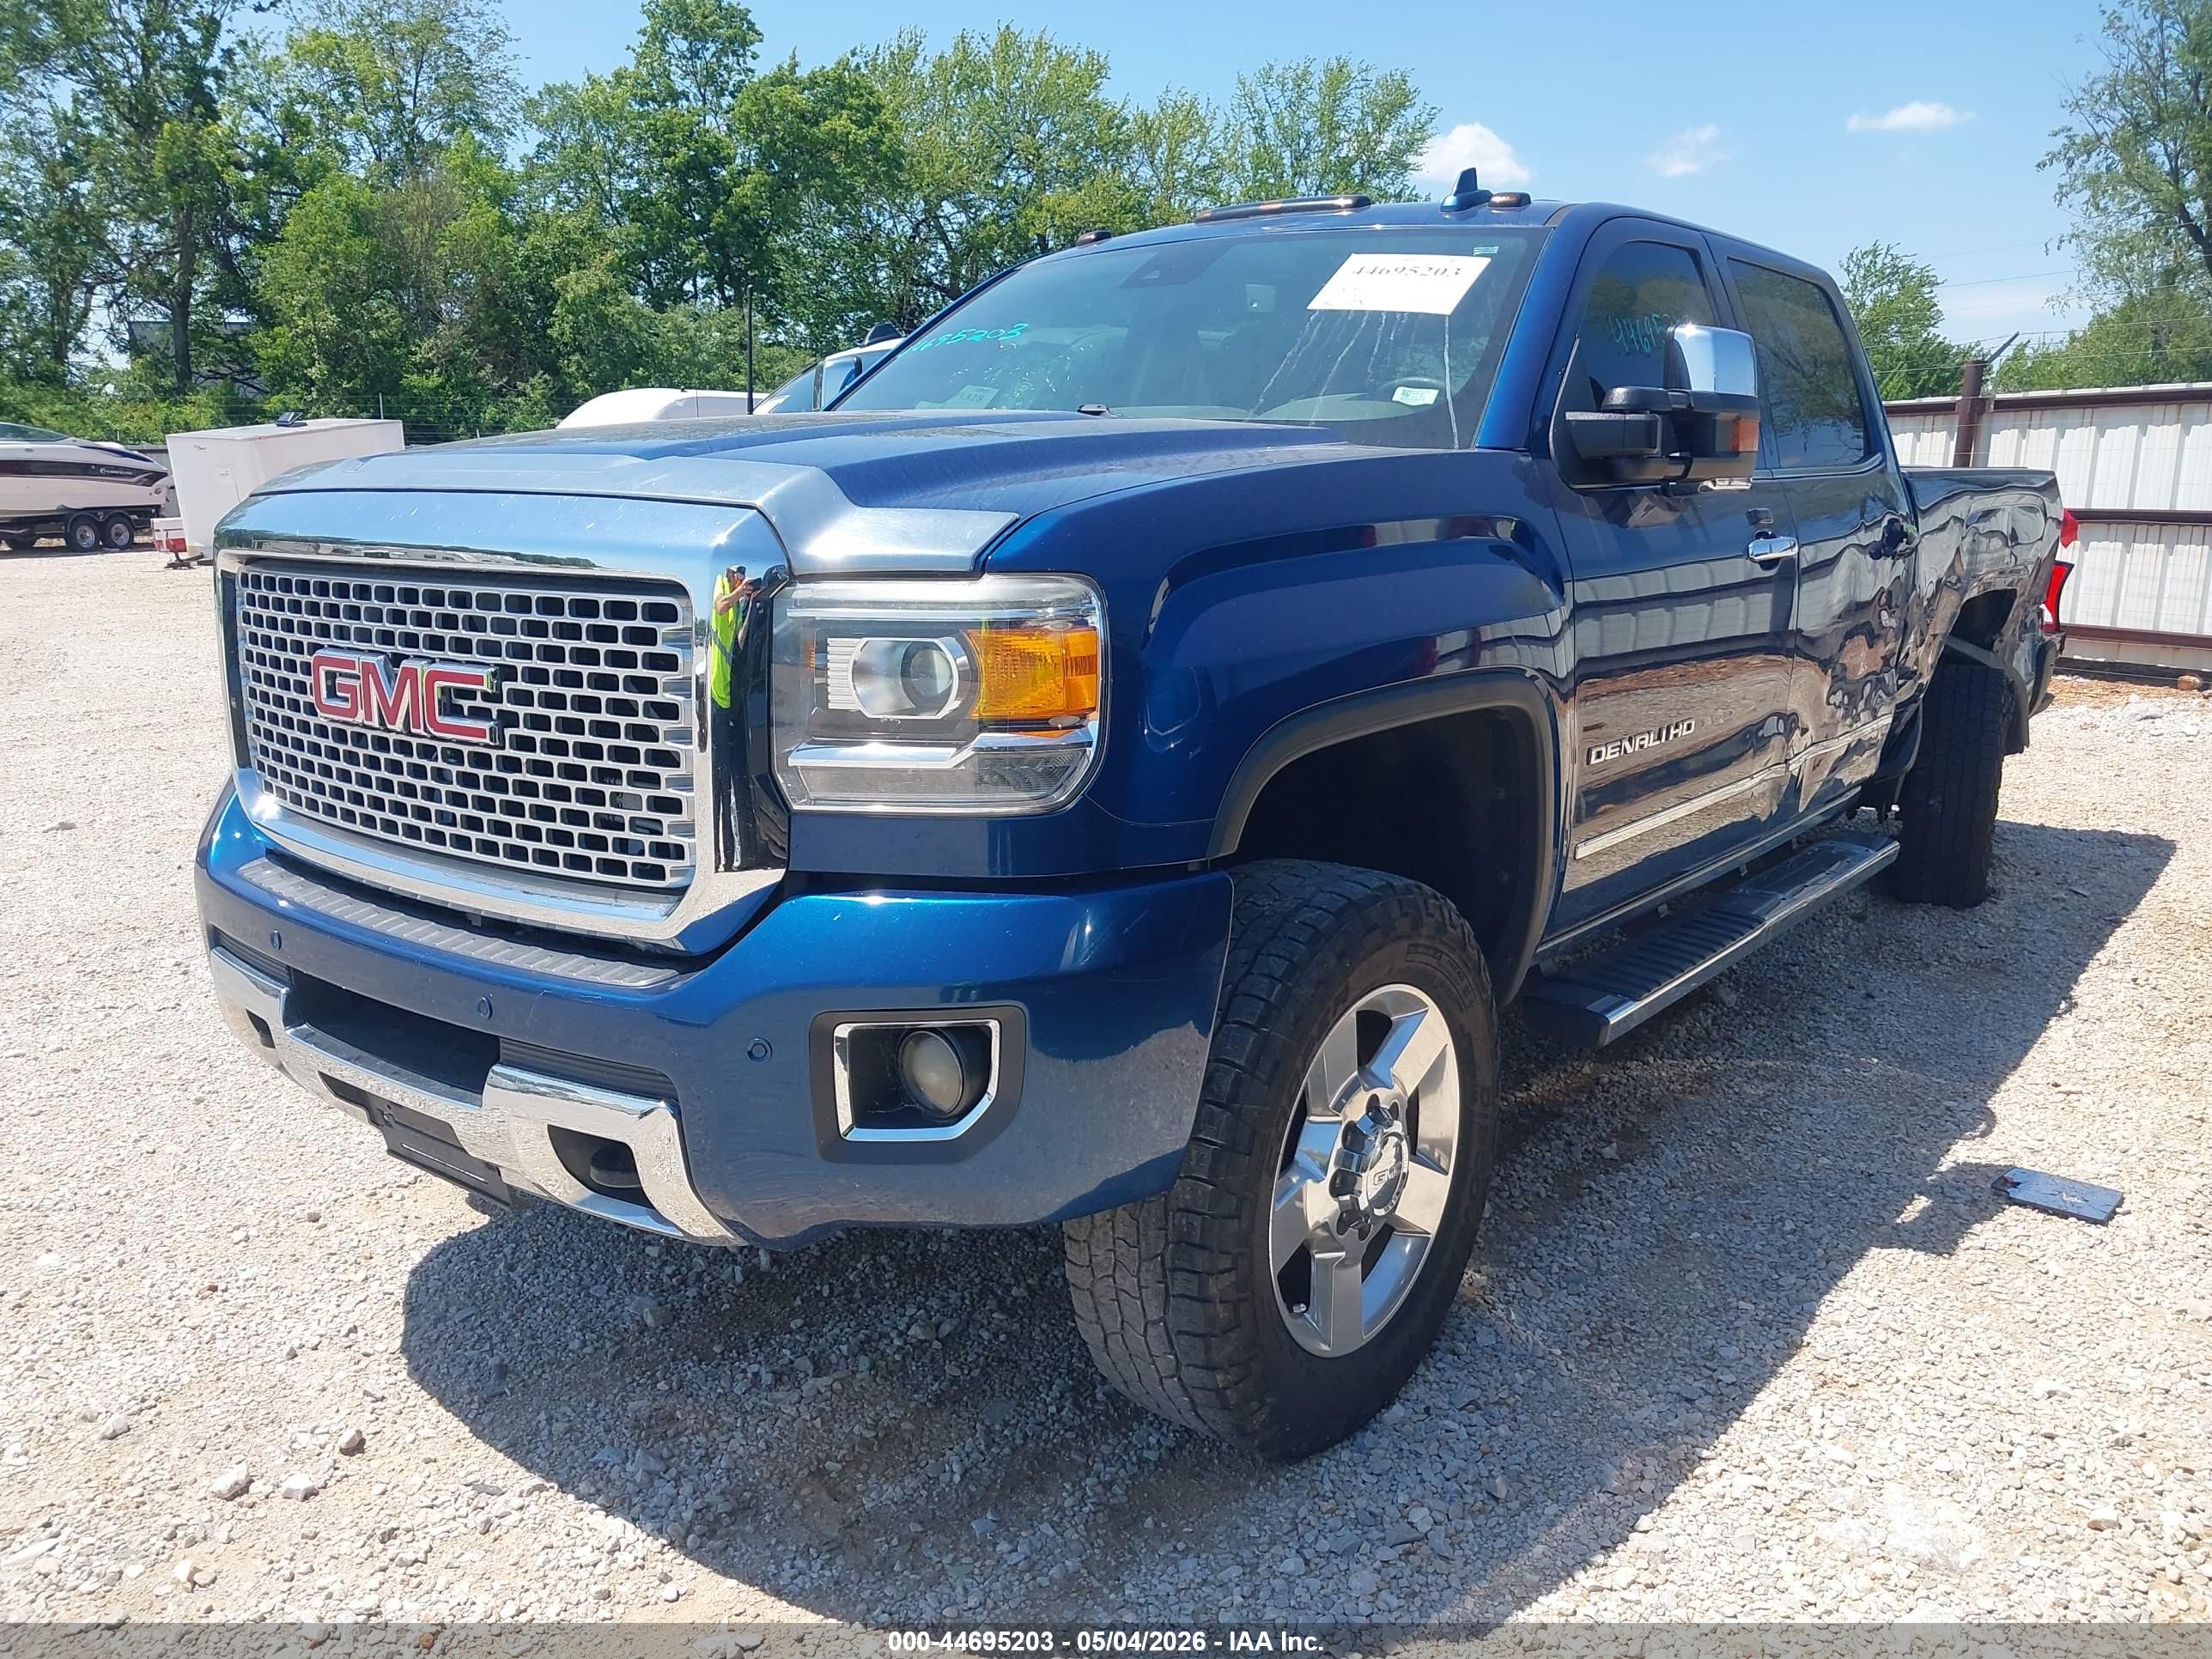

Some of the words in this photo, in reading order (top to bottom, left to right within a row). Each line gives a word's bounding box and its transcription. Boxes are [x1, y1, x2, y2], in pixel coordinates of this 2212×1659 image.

[312, 647, 499, 745] GMC
[1587, 726, 1667, 765] DENALI
[1668, 717, 1696, 740] HD
[1373, 1162, 1402, 1186] GMC
